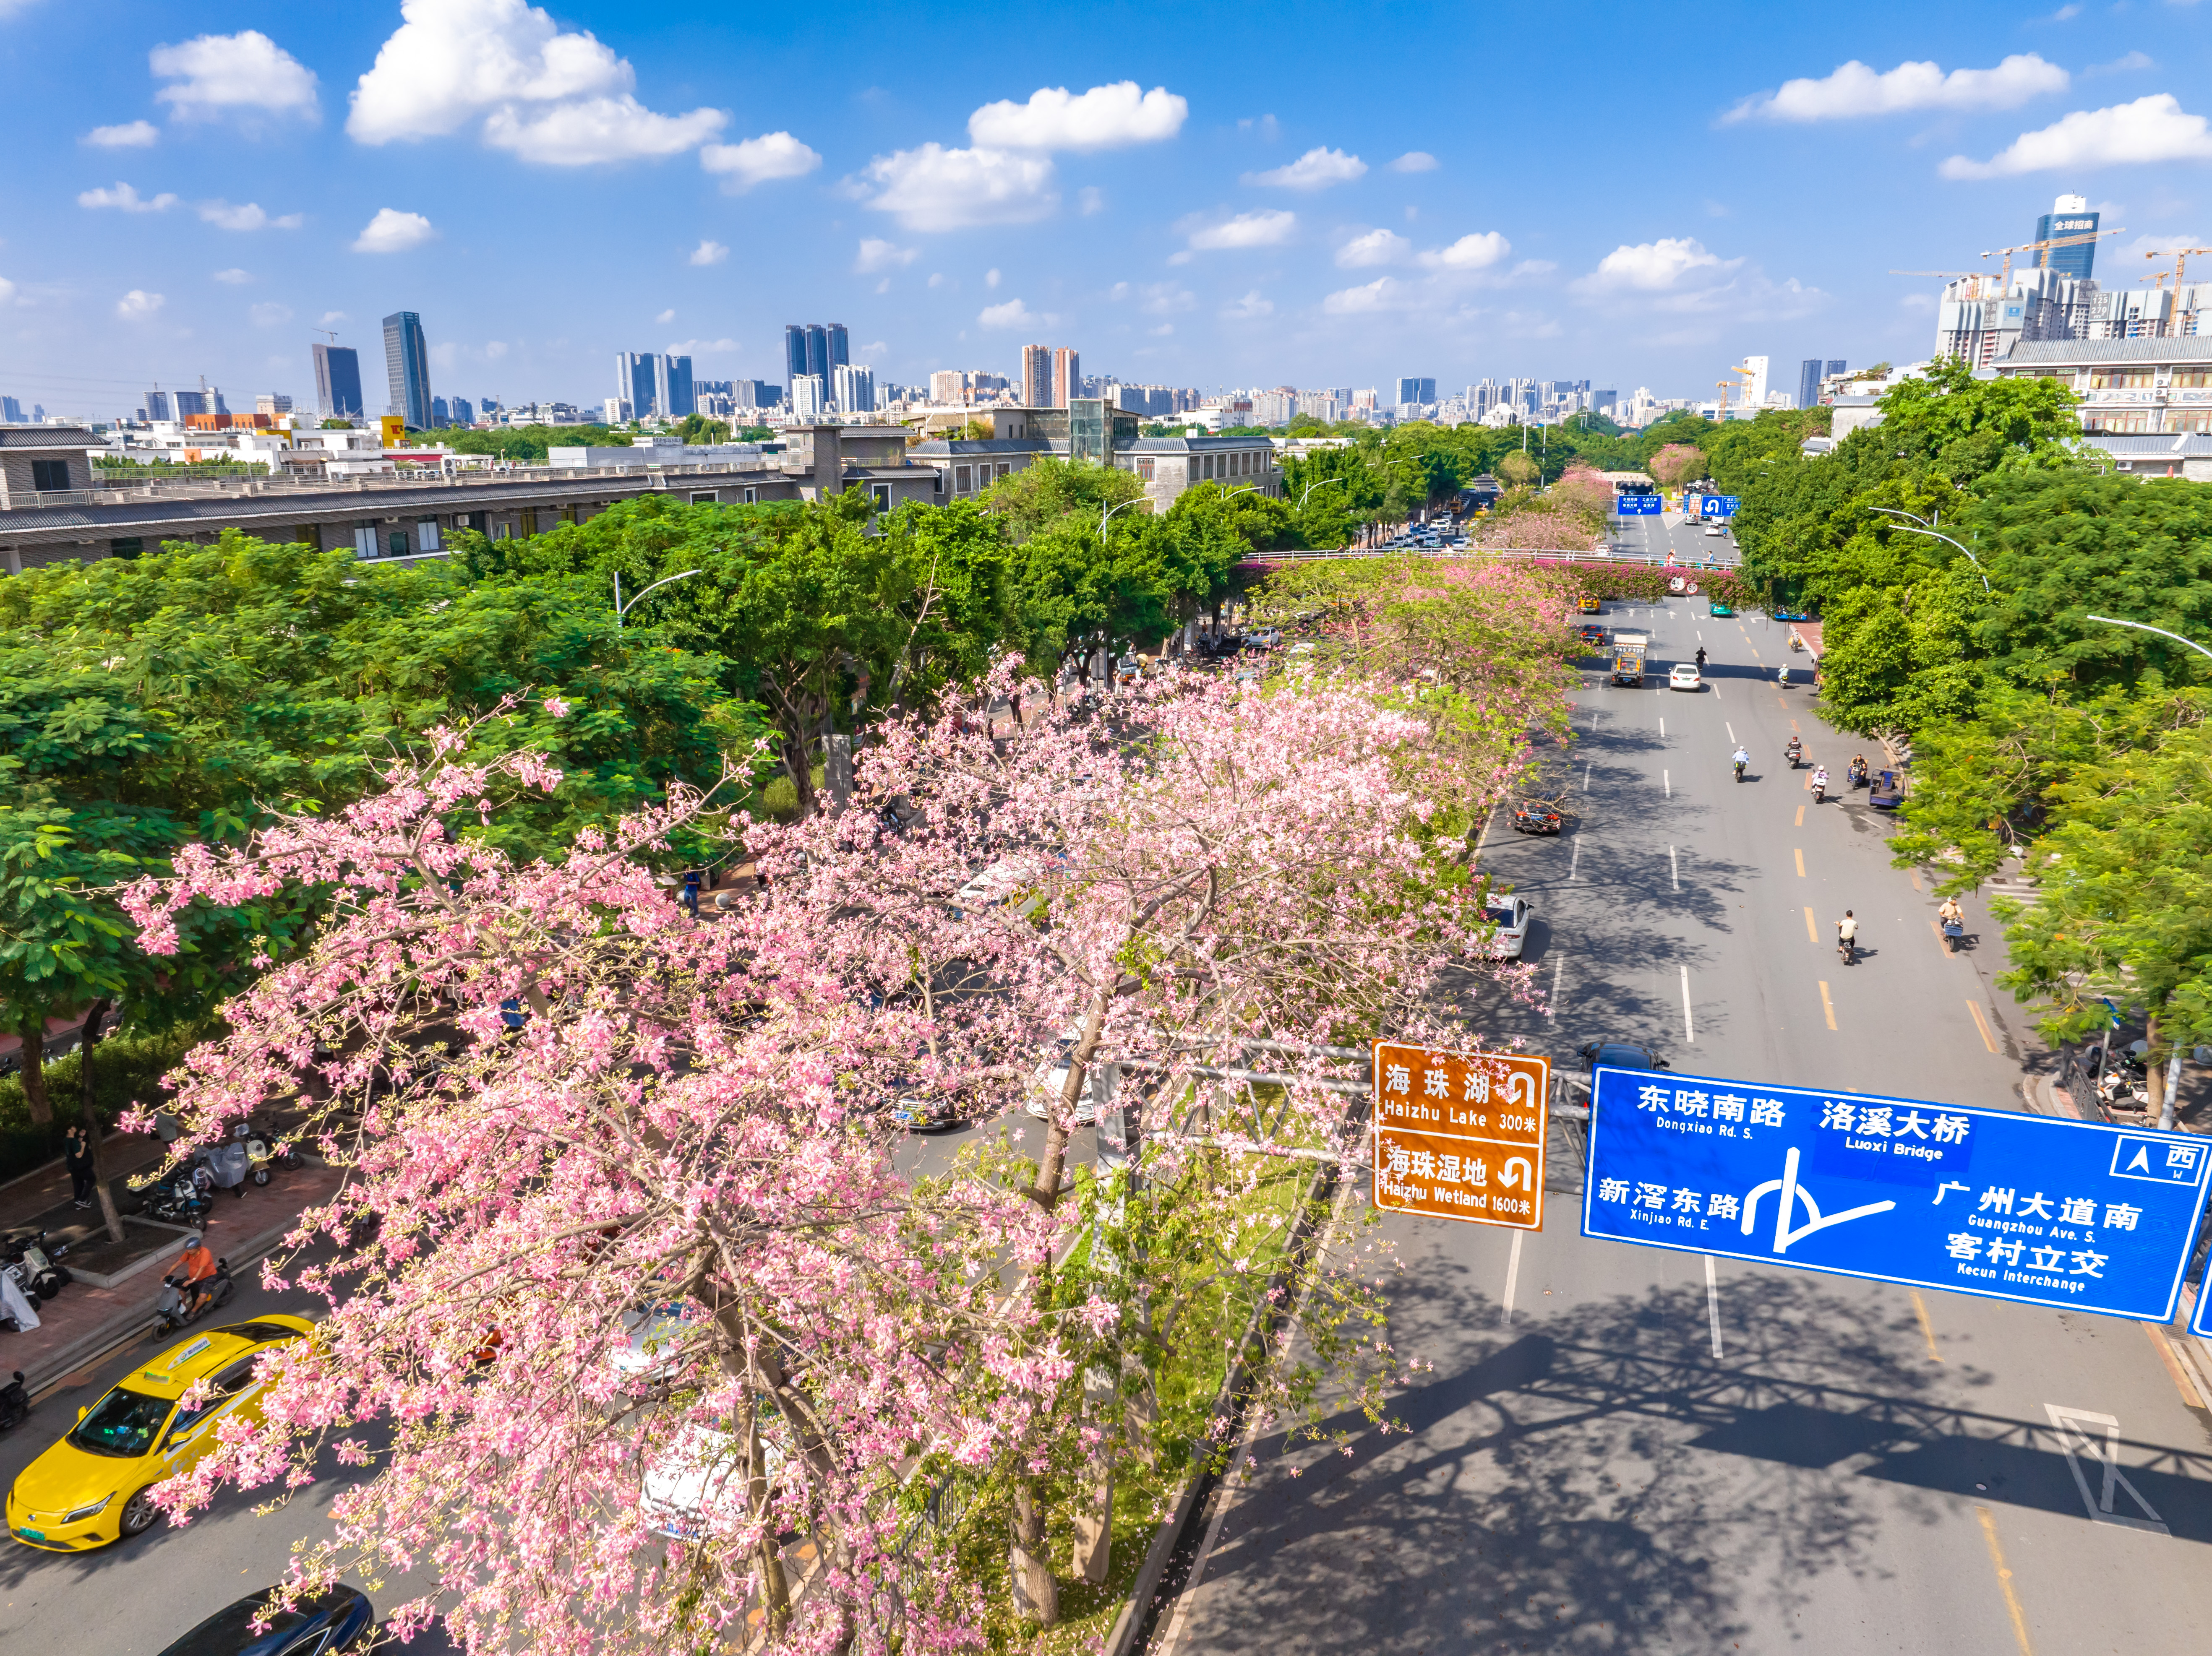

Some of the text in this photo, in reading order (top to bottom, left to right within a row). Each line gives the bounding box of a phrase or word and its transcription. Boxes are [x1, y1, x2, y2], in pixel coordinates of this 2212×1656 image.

[2055, 220, 2094, 230] 全球招商
[1385, 1064, 1489, 1104] 海珠湖
[1385, 1099, 1487, 1127] Haizhu Lake
[1636, 1085, 1786, 1127] 东晓南路
[1499, 1114, 1536, 1133] 300米
[1656, 1115, 1753, 1139] Dongxiao Rd. S.
[1819, 1100, 1970, 1144] 洛溪大桥
[1845, 1136, 1943, 1161] Luoxi Bridge
[2166, 1145, 2199, 1169] 西
[1386, 1149, 1487, 1187] 海珠湿地
[2173, 1170, 2183, 1179] W
[1384, 1181, 1487, 1208] Haizhu Wetland
[1492, 1196, 1530, 1215] 1600米
[1598, 1177, 1740, 1222] 新滘东路
[1932, 1181, 2143, 1231] 广州大道南
[1630, 1208, 1709, 1230] Xinjiao Rd. E.
[1968, 1214, 2095, 1243] Guangzhou Ave. S.
[1945, 1232, 2109, 1278] 客村立交
[1957, 1263, 2085, 1293] Kecun Interchange
